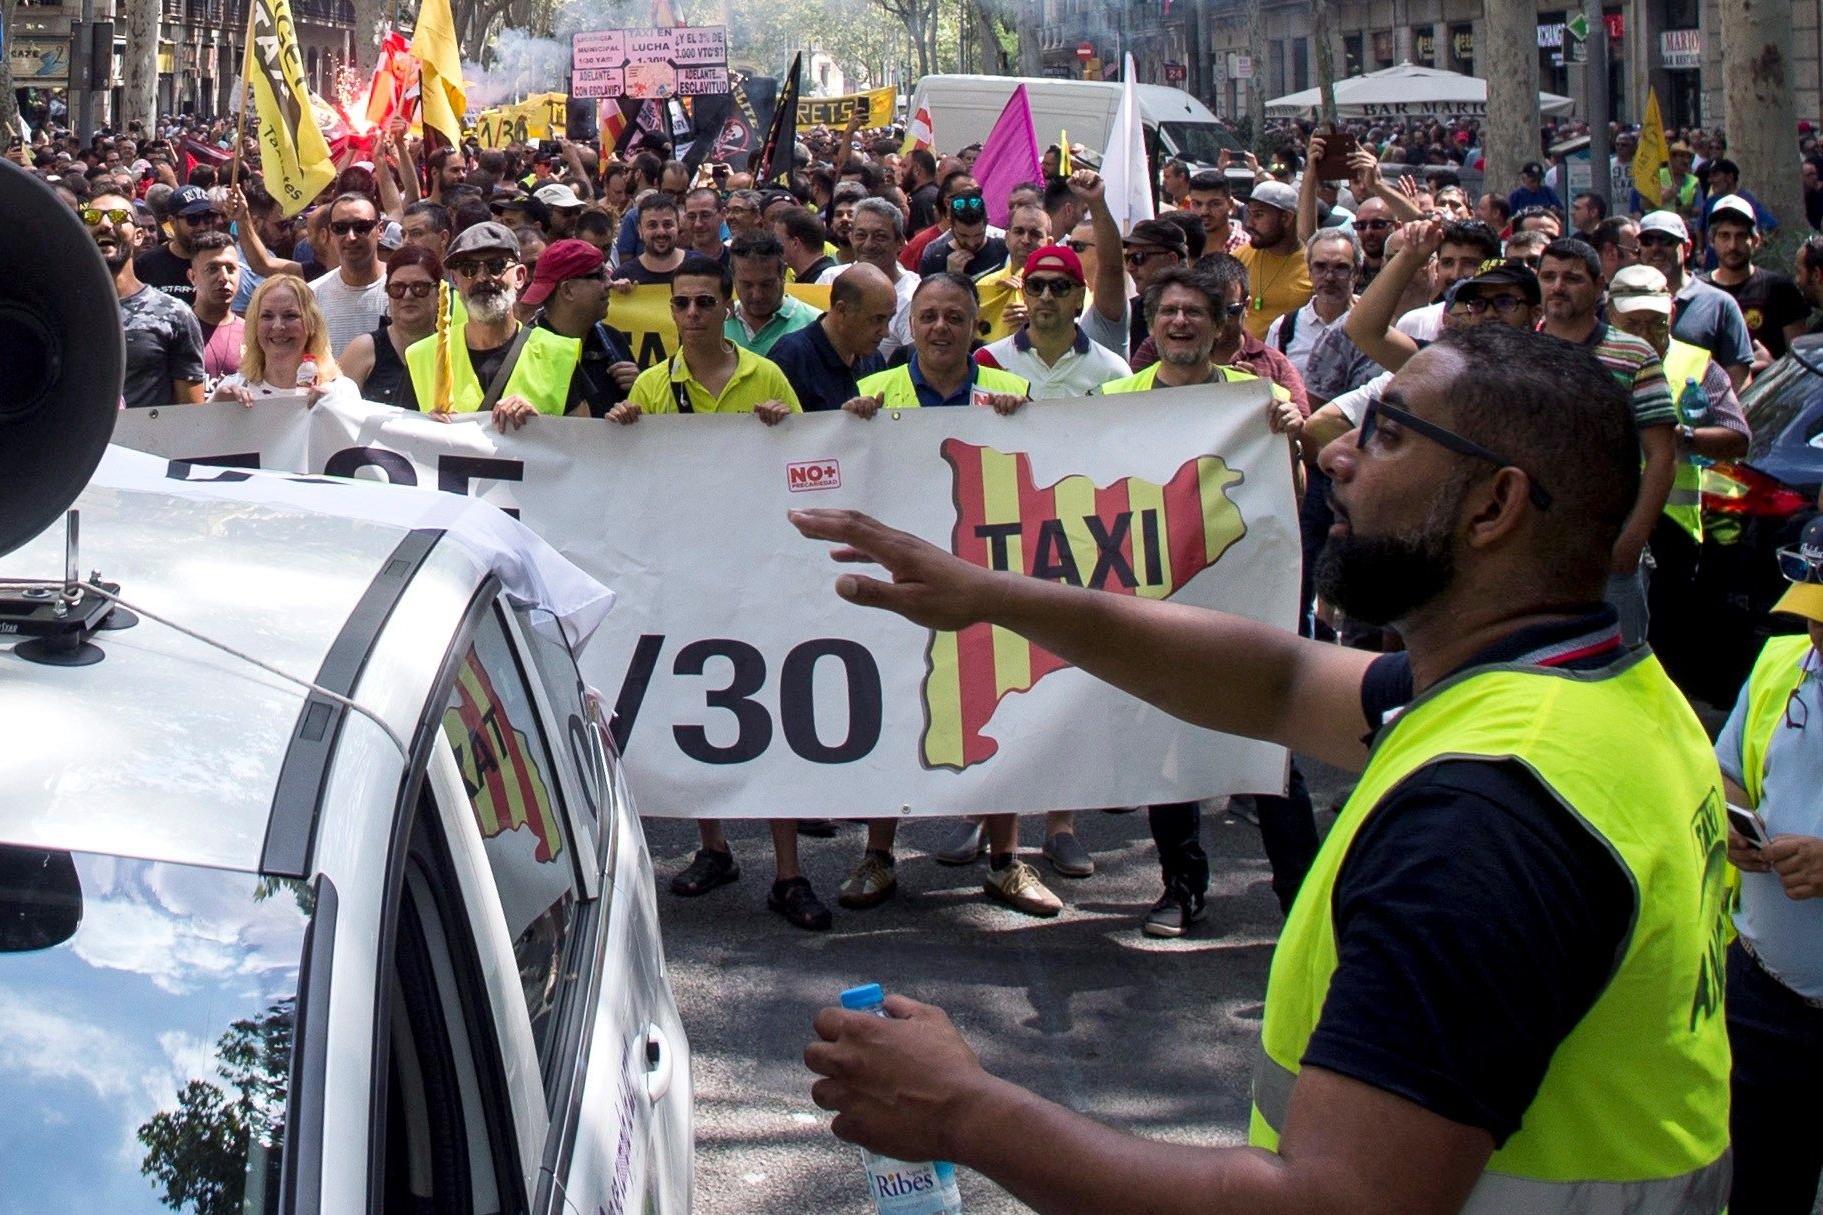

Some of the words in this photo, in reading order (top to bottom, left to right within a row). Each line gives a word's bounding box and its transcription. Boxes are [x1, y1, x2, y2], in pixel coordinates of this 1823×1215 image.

[658, 28, 672, 36] EN
[686, 33, 696, 43] EL
[712, 32, 723, 43] DE
[632, 43, 670, 51] LUCHA
[574, 86, 588, 96] CON
[679, 81, 728, 94] ESCLAVITUD
[1363, 102, 1409, 116] BAR
[790, 465, 836, 484] NO+
[791, 479, 838, 489] PRECARIEDAD
[974, 507, 1164, 589] TAXI
[876, 1172, 934, 1198] Ribes
